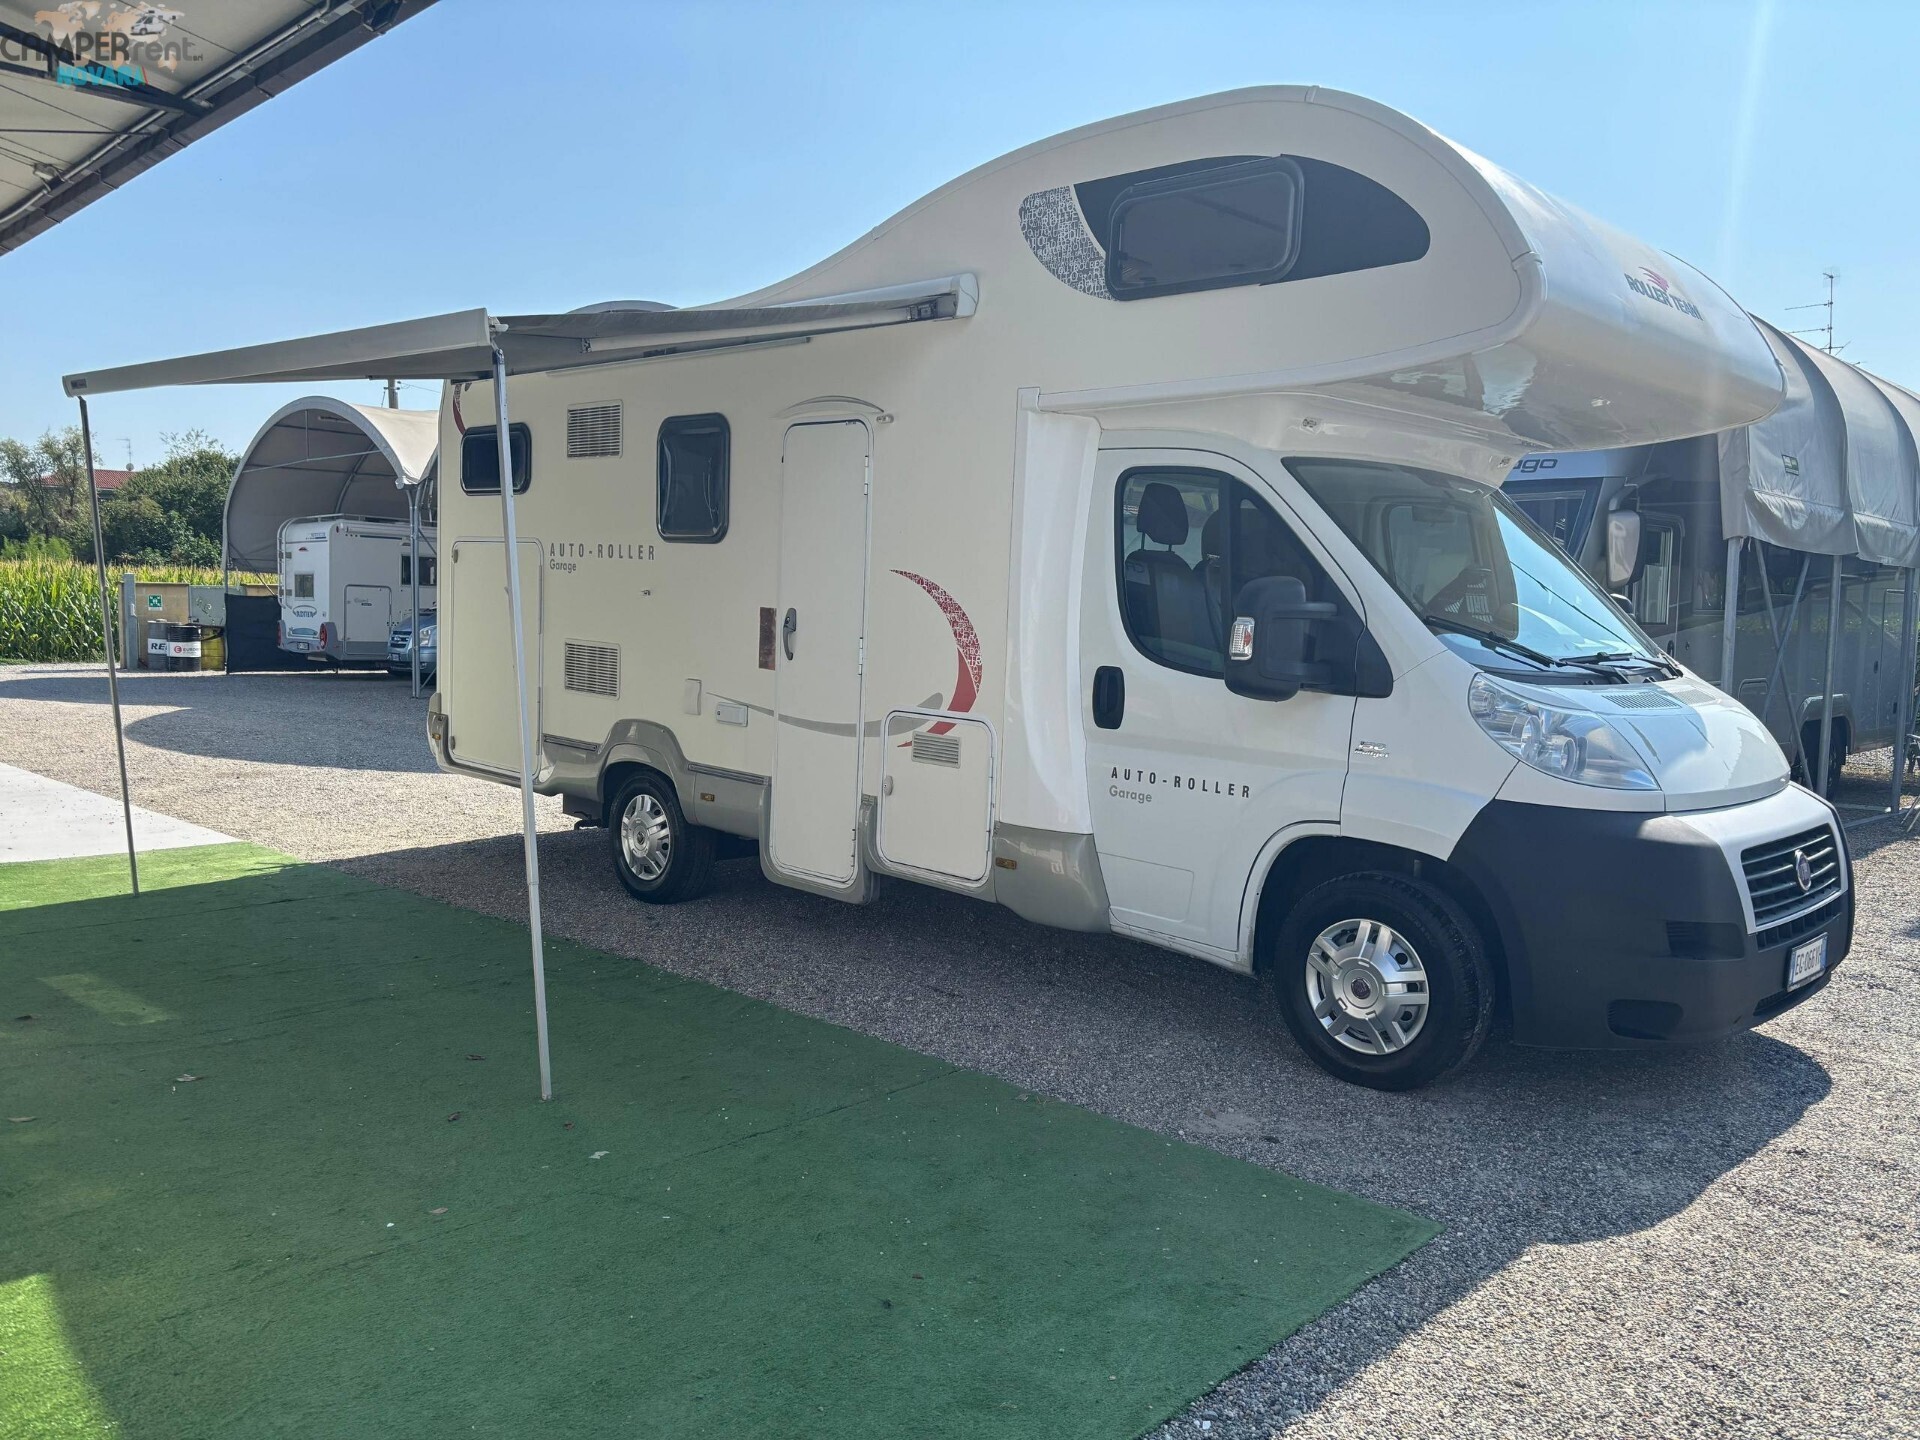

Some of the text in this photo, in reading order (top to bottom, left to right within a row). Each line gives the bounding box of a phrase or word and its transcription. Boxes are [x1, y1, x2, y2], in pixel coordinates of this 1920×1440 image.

[1624, 273, 1704, 321] ROLLER TEAM
[549, 543, 655, 560] AUTO-ROLLER
[549, 558, 577, 573] Garage
[151, 642, 168, 651] RE
[1111, 766, 1250, 798] AUTO-ROLLER
[1109, 785, 1152, 803] Garage
